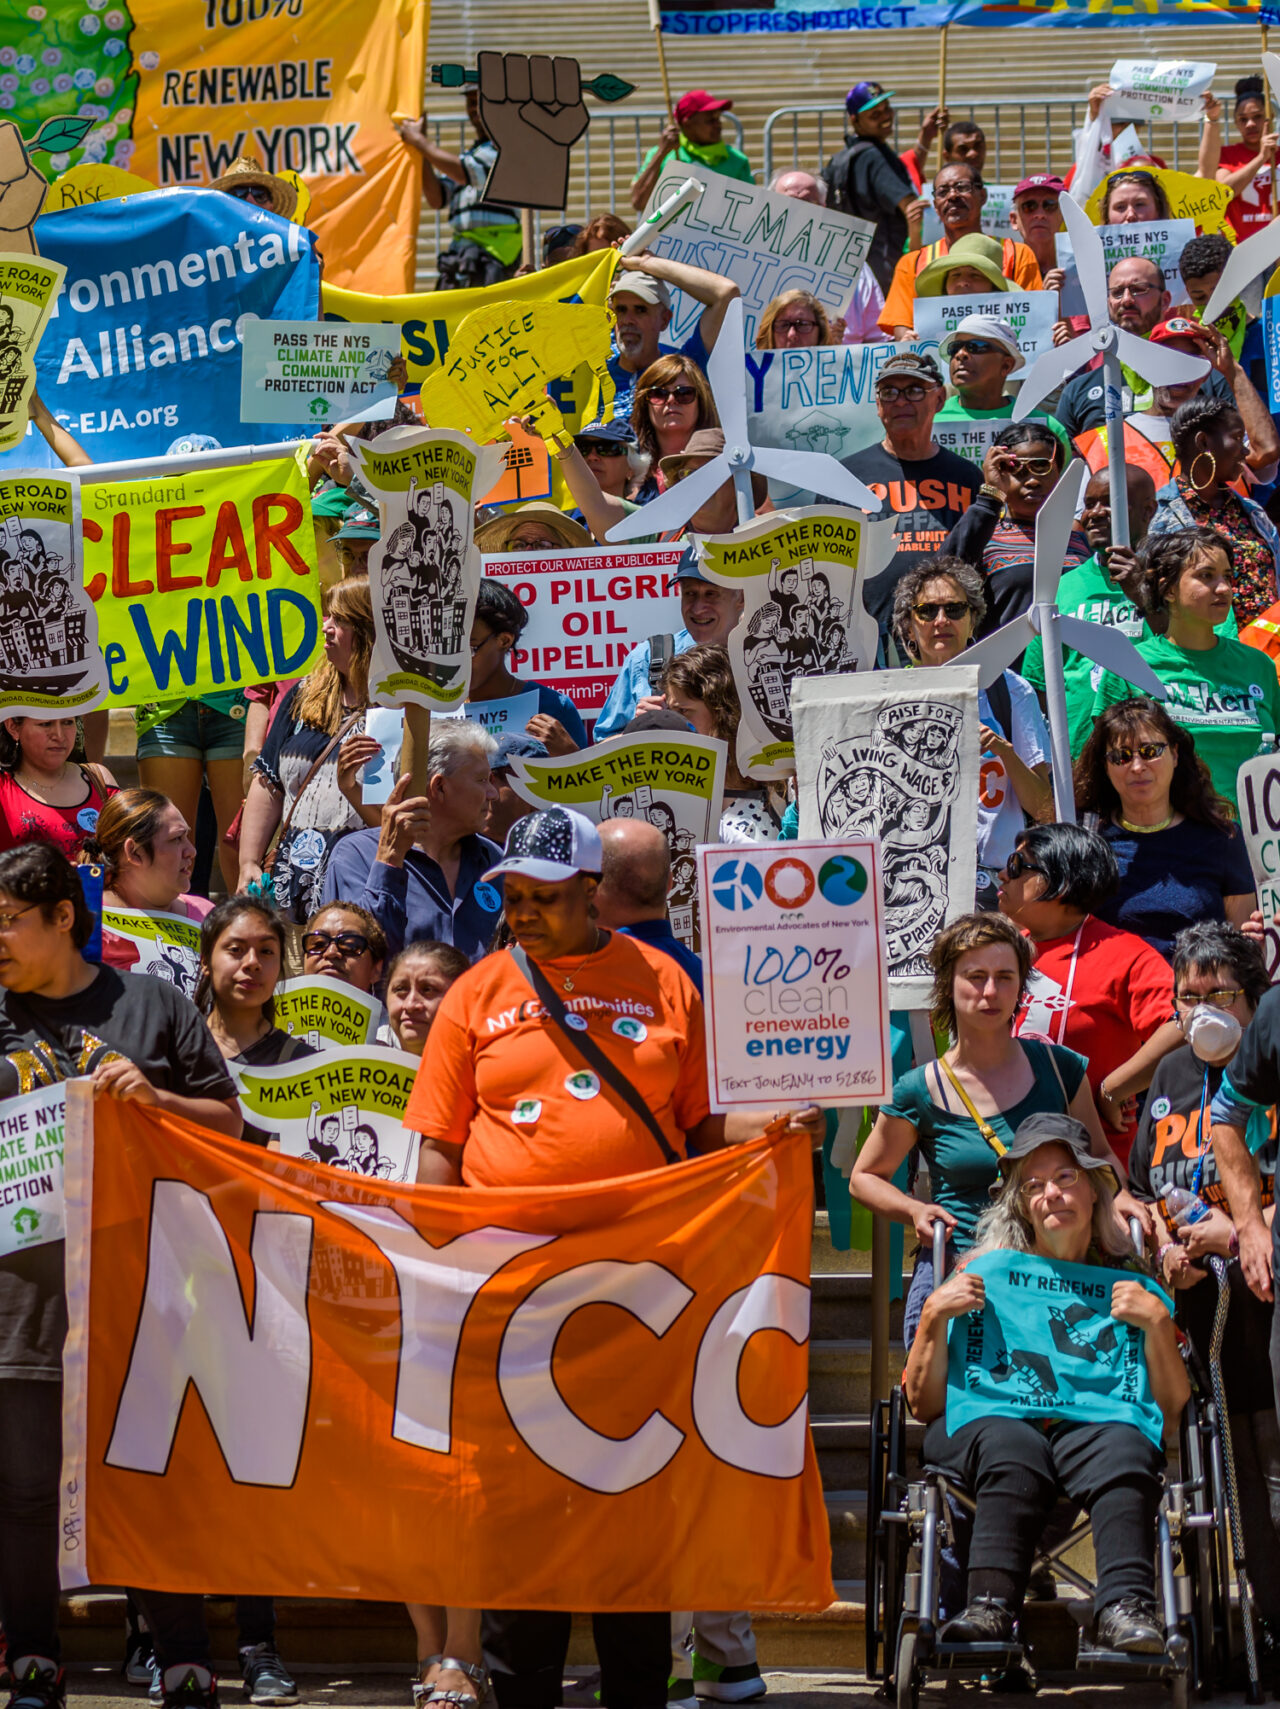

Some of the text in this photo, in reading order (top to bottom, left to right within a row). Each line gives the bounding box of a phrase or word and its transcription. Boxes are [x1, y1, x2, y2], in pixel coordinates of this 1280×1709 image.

[163, 60, 332, 106] RENEWABLE
[1121, 90, 1174, 104] PROTECTION
[159, 124, 362, 183] NEW YORK
[652, 175, 873, 278] CLIMATE
[7, 267, 52, 287] ROAD
[15, 283, 47, 300] YORK
[274, 333, 370, 349] PASS THE NYS
[448, 311, 535, 382] JUSTICE
[277, 349, 333, 363] CLIMATE
[487, 346, 529, 376] FOR
[1266, 308, 1280, 404] GOVERNOR
[282, 364, 361, 378] COMMUNITY
[265, 379, 377, 394] PROTECTION ACT
[483, 356, 546, 413] ALL!
[373, 447, 473, 476] MAKE THE ROAD
[424, 465, 450, 481] NEW
[15, 485, 67, 500] ROAD
[94, 483, 186, 511] Standard
[28, 500, 67, 516] YORK
[488, 554, 653, 575] PROTECT OUR WATER PUBLIC
[562, 611, 628, 637] OIL
[128, 588, 318, 691] WIND
[25, 695, 65, 705] COMUNIDAD
[72, 691, 93, 704] PODER
[888, 705, 954, 725] RISE FOR
[841, 747, 940, 796] LIVING WAGE
[716, 919, 870, 934] Environmental Advocates of New York
[743, 944, 851, 987] 100%
[291, 994, 365, 1027] THE ROAD
[743, 981, 849, 1016] clean
[300, 1013, 327, 1029] NEW
[486, 1007, 518, 1033] NY
[745, 1013, 851, 1034] renewable
[746, 1034, 851, 1061] energy
[835, 1070, 878, 1085] 52886
[1008, 1271, 1107, 1299] NY RENEWS
[104, 1178, 811, 1495] NYCC
